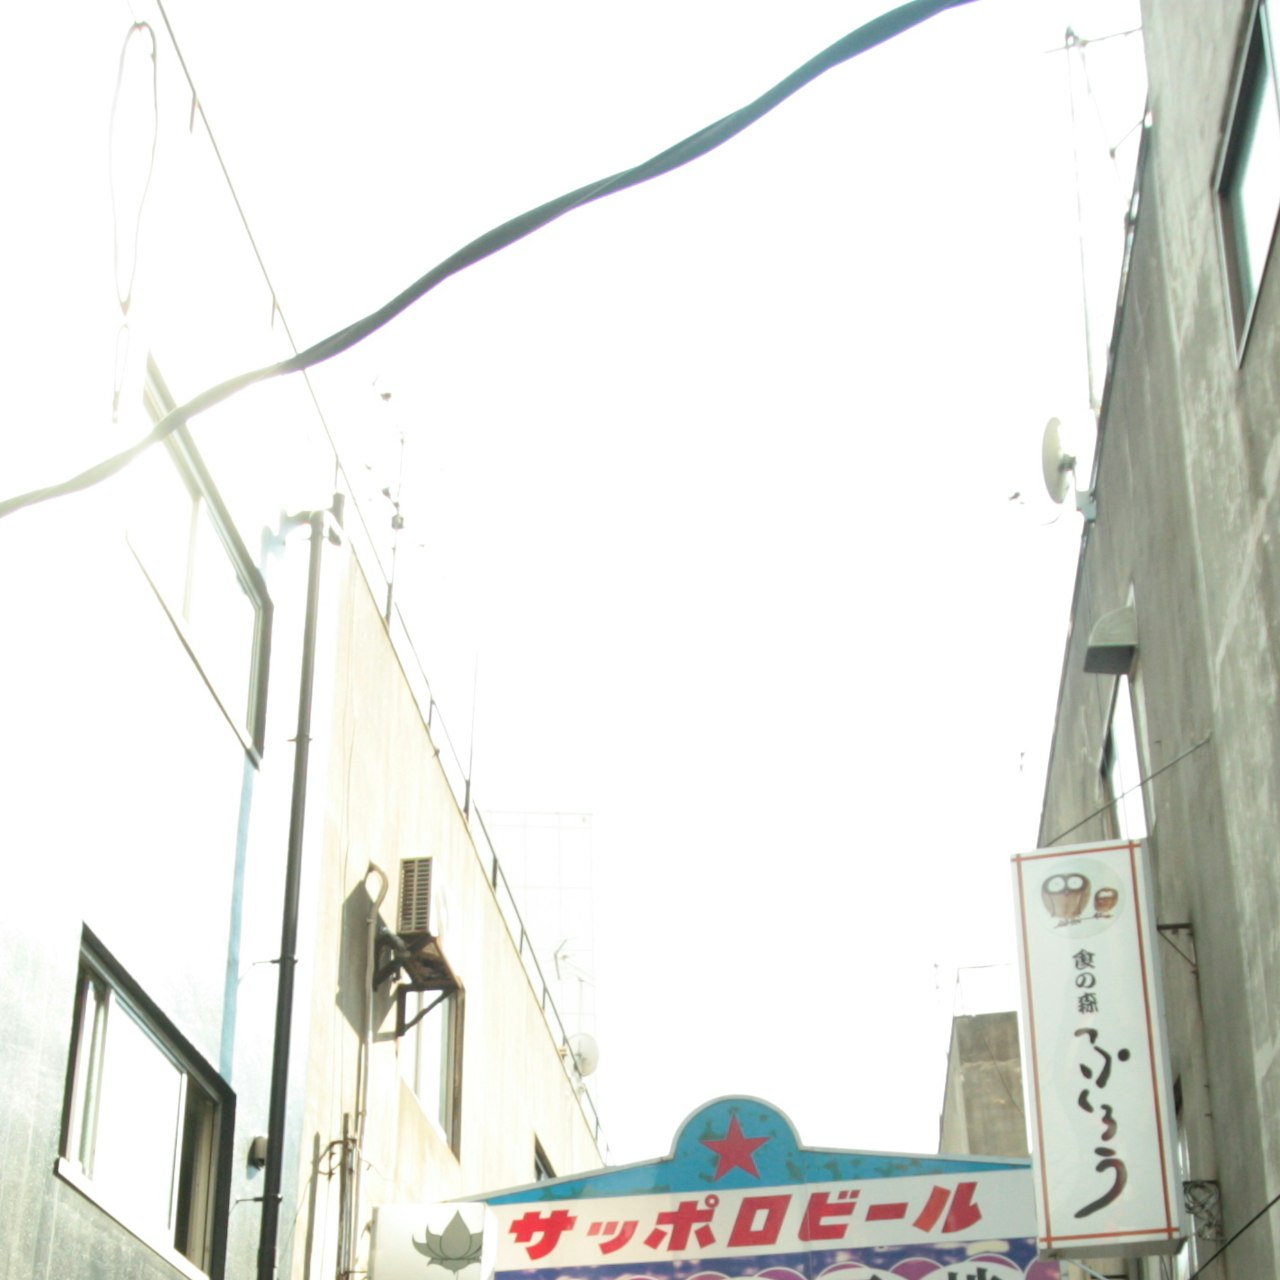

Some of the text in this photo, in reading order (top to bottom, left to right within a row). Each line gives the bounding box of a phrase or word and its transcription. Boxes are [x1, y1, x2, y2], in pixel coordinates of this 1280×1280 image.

[508, 1181, 983, 1261] サッポロビール
